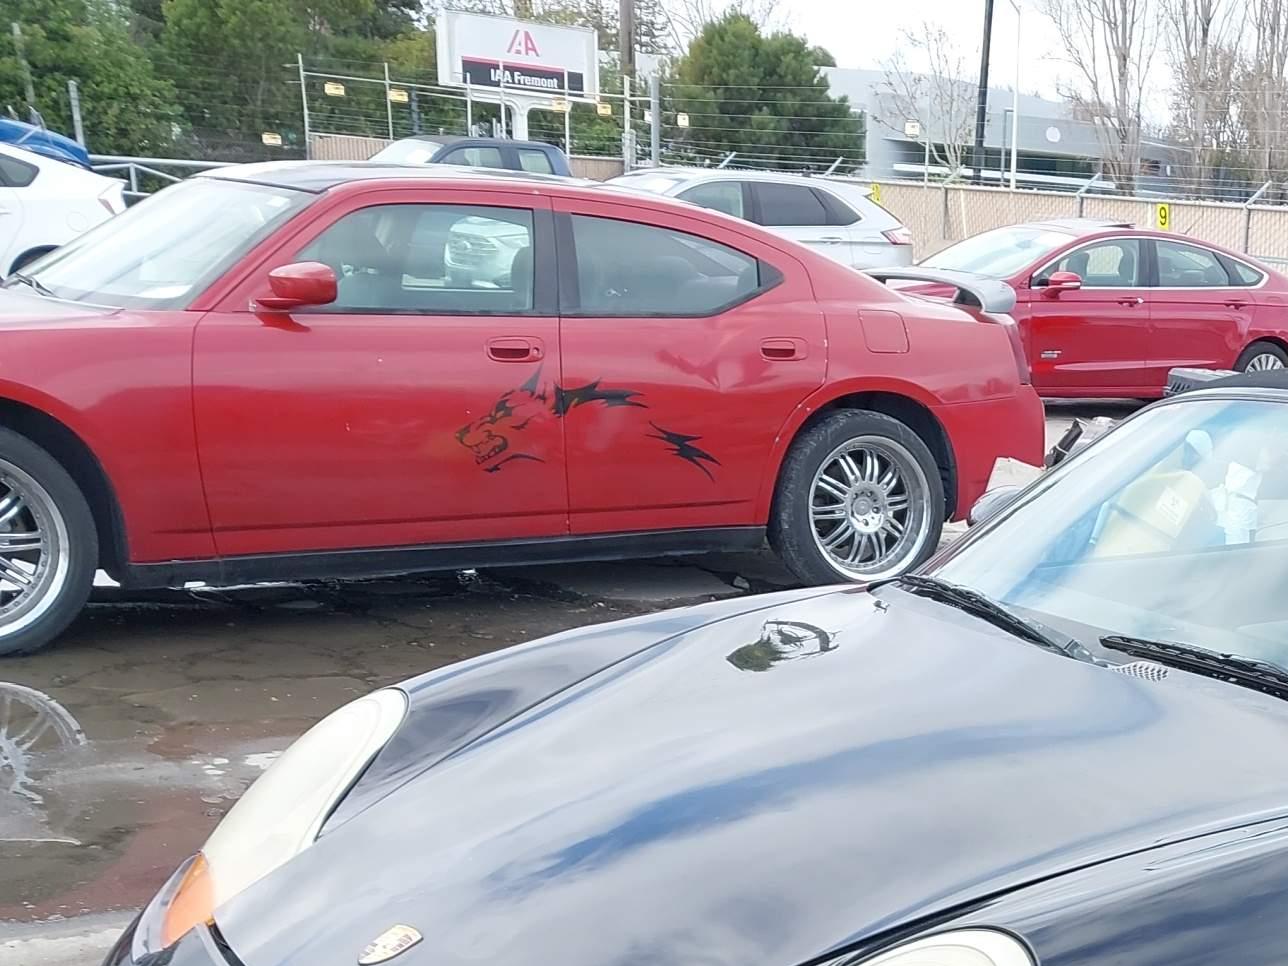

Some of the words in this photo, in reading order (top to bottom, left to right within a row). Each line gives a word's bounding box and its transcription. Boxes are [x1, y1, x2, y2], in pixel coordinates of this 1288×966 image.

[490, 68, 512, 82] IAA
[514, 72, 559, 89] Fremont
[1159, 206, 1167, 226] 9
